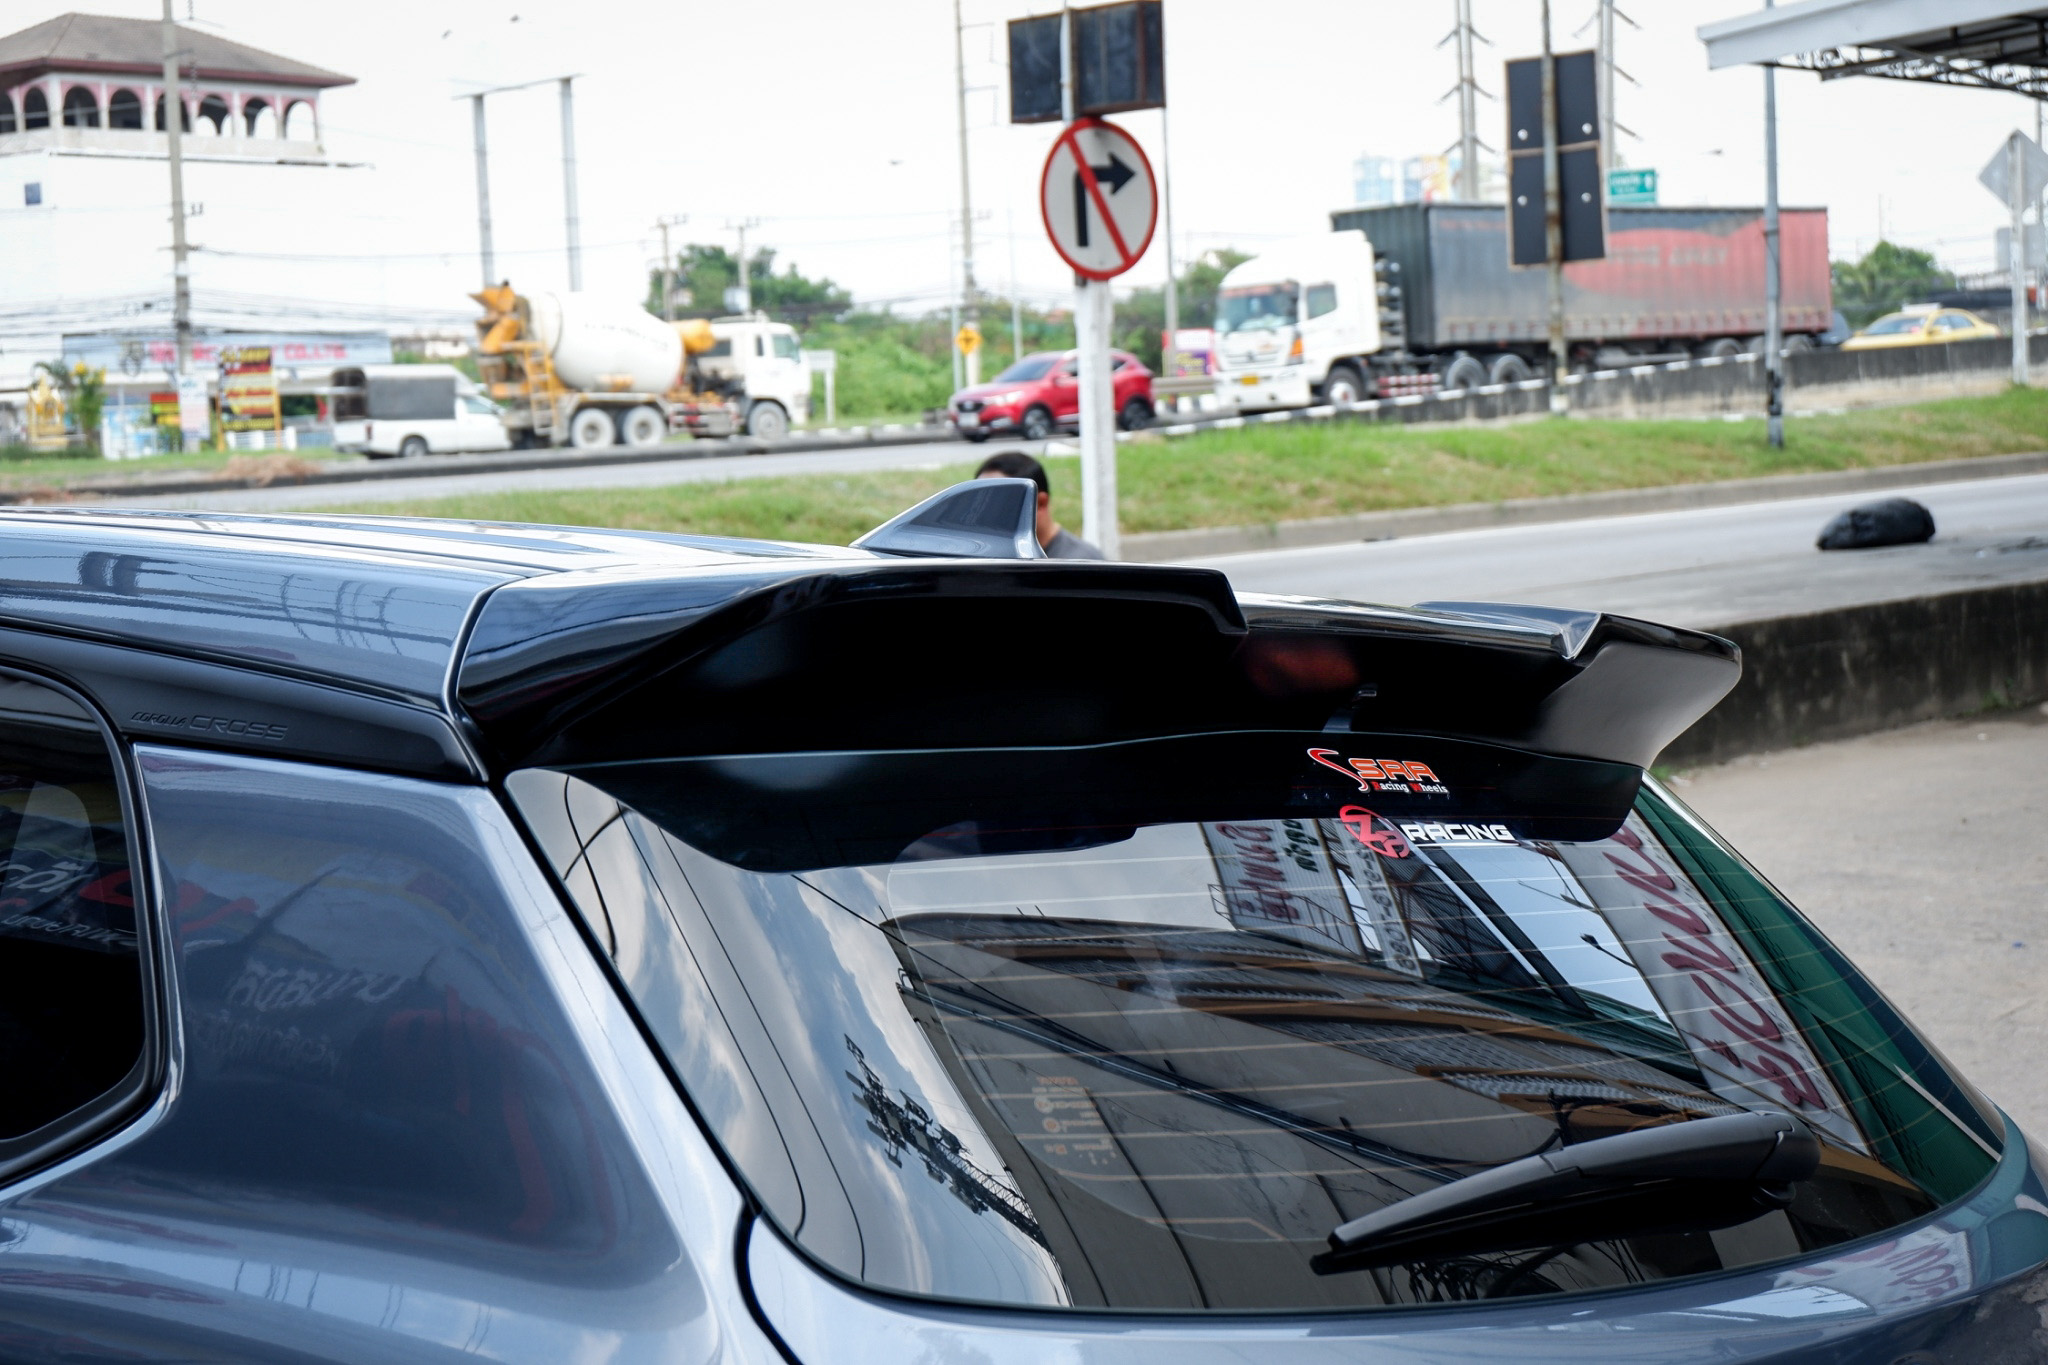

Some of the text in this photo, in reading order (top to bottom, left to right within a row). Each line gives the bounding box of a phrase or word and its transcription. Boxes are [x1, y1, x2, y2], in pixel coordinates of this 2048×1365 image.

[131, 711, 288, 741] COROLLA CROSS
[1370, 780, 1449, 794] Racing Wheels
[1400, 823, 1517, 841] RACING
